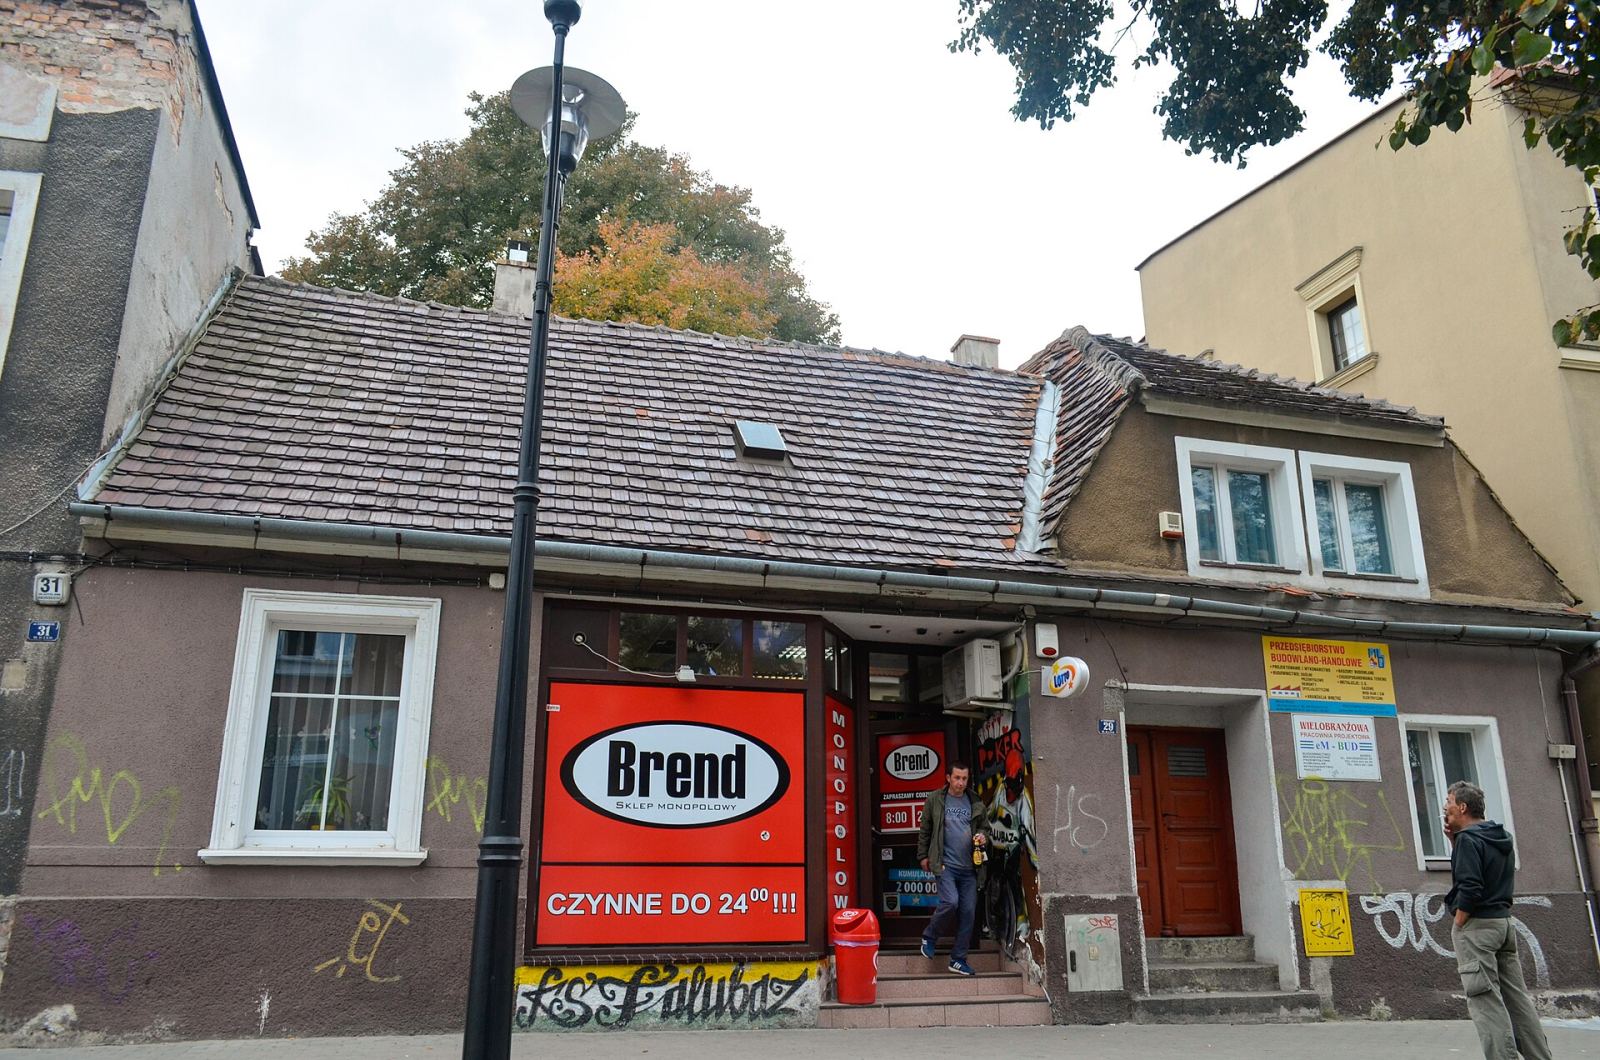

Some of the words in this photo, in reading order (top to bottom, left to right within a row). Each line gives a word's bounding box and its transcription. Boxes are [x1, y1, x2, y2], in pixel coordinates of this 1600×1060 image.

[40, 577, 60, 593] 31
[37, 625, 51, 637] 31
[1269, 641, 1345, 655] PRZEDSIĘBIORSTWO
[1270, 653, 1363, 667] BUDOWLANO-HANDLOWE
[1054, 670, 1070, 688] LOTTO
[1103, 722, 1114, 731] 29
[1299, 721, 1369, 733] WIELOBRANŻOWA
[1338, 741, 1358, 751] BUD
[893, 750, 930, 772] Brend
[607, 740, 747, 799] Brend
[883, 792, 914, 800] ZAPRASZAMY
[832, 710, 849, 909] MONOPOLOW
[886, 811, 907, 824] 8:00
[896, 881, 902, 892] 2
[904, 882, 923, 893] 000
[925, 882, 938, 893] 00
[547, 893, 662, 915] CZYNNE
[670, 893, 711, 915] DO
